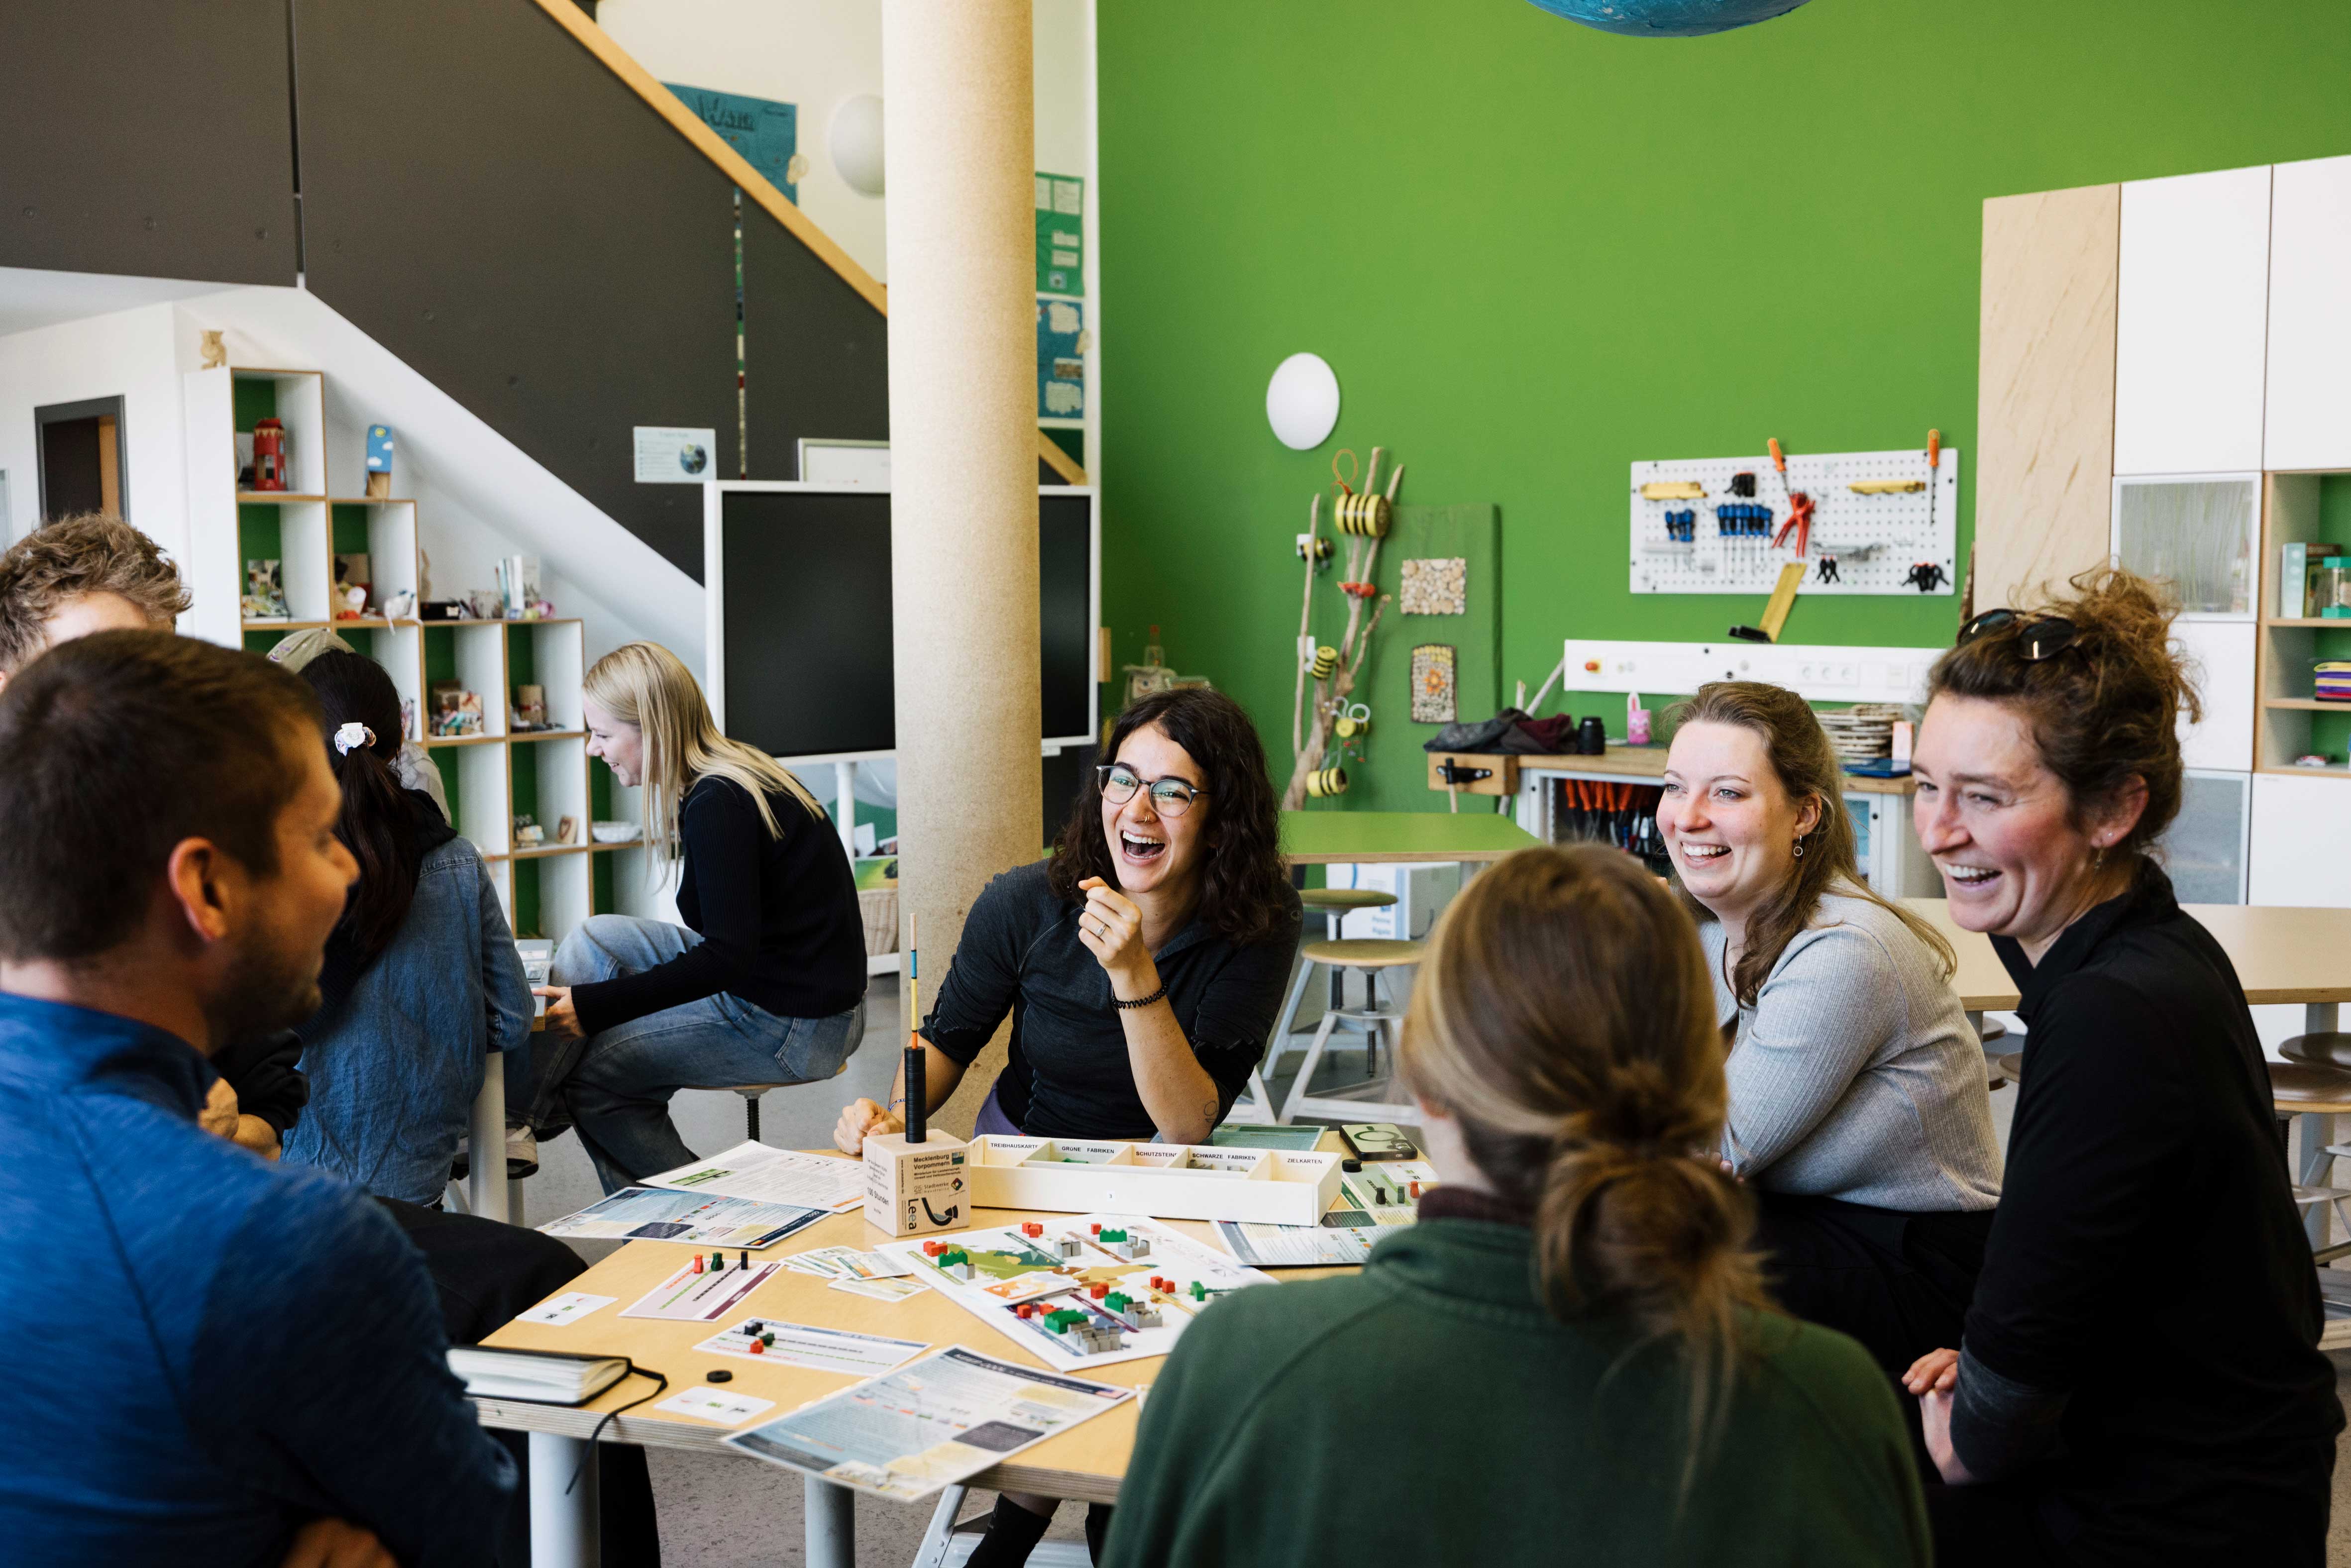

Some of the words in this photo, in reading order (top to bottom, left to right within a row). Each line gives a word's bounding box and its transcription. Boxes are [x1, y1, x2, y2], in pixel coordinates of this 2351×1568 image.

[913, 1154, 950, 1162] Mecklenburg
[913, 1161, 950, 1170] Vorpommern
[908, 1198, 919, 1230] Leea
